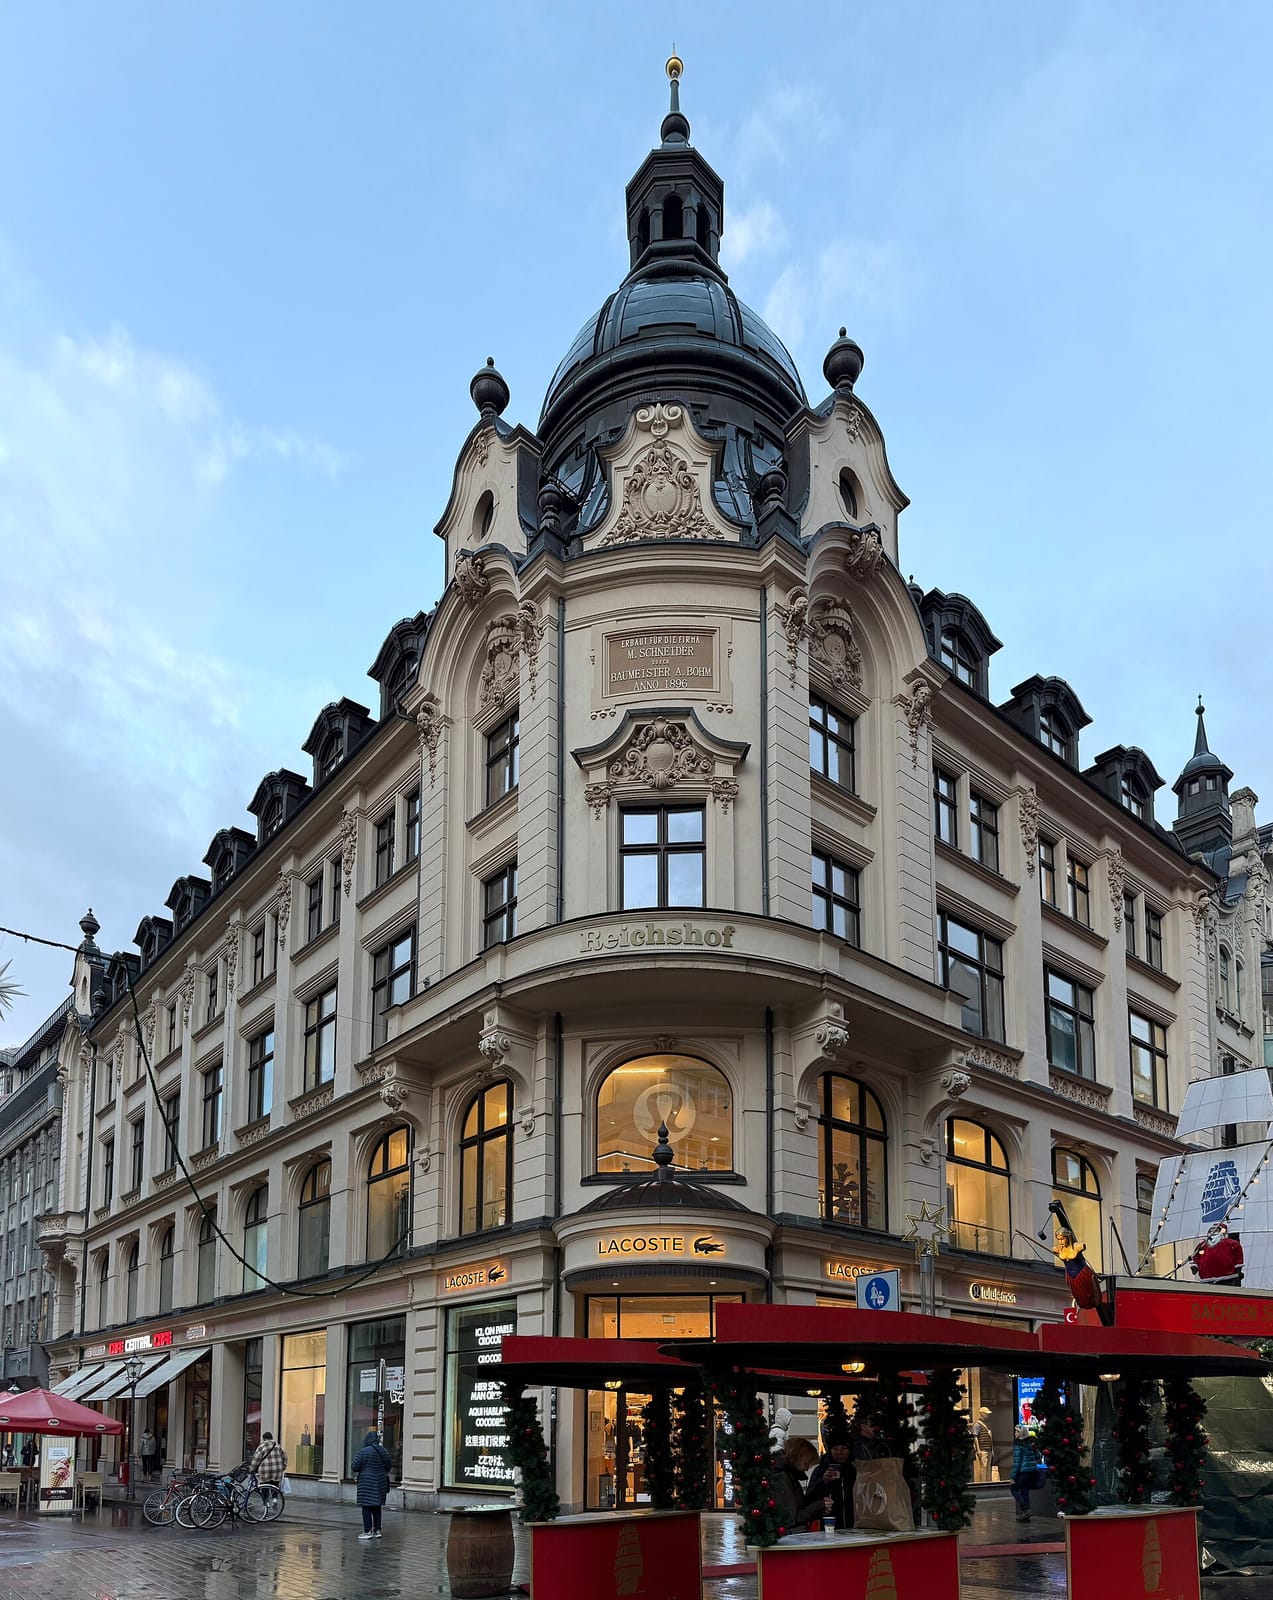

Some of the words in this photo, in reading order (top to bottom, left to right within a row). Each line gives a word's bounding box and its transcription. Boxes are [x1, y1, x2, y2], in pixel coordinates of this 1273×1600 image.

[621, 638, 647, 648] ERBAUT
[664, 636, 677, 644] DIE
[678, 636, 700, 644] FIRMA
[627, 649, 637, 660] M.
[639, 646, 694, 658] SCHNEIDER
[610, 667, 671, 683] BAUMEISTER
[633, 680, 659, 691] ANNO
[664, 678, 688, 689] 1896
[580, 922, 736, 953] Reichshof
[598, 1236, 684, 1254] LACOSTE
[444, 1271, 484, 1289] LACOSTE
[485, 1326, 495, 1336] ON
[470, 1391, 486, 1400] MAN
